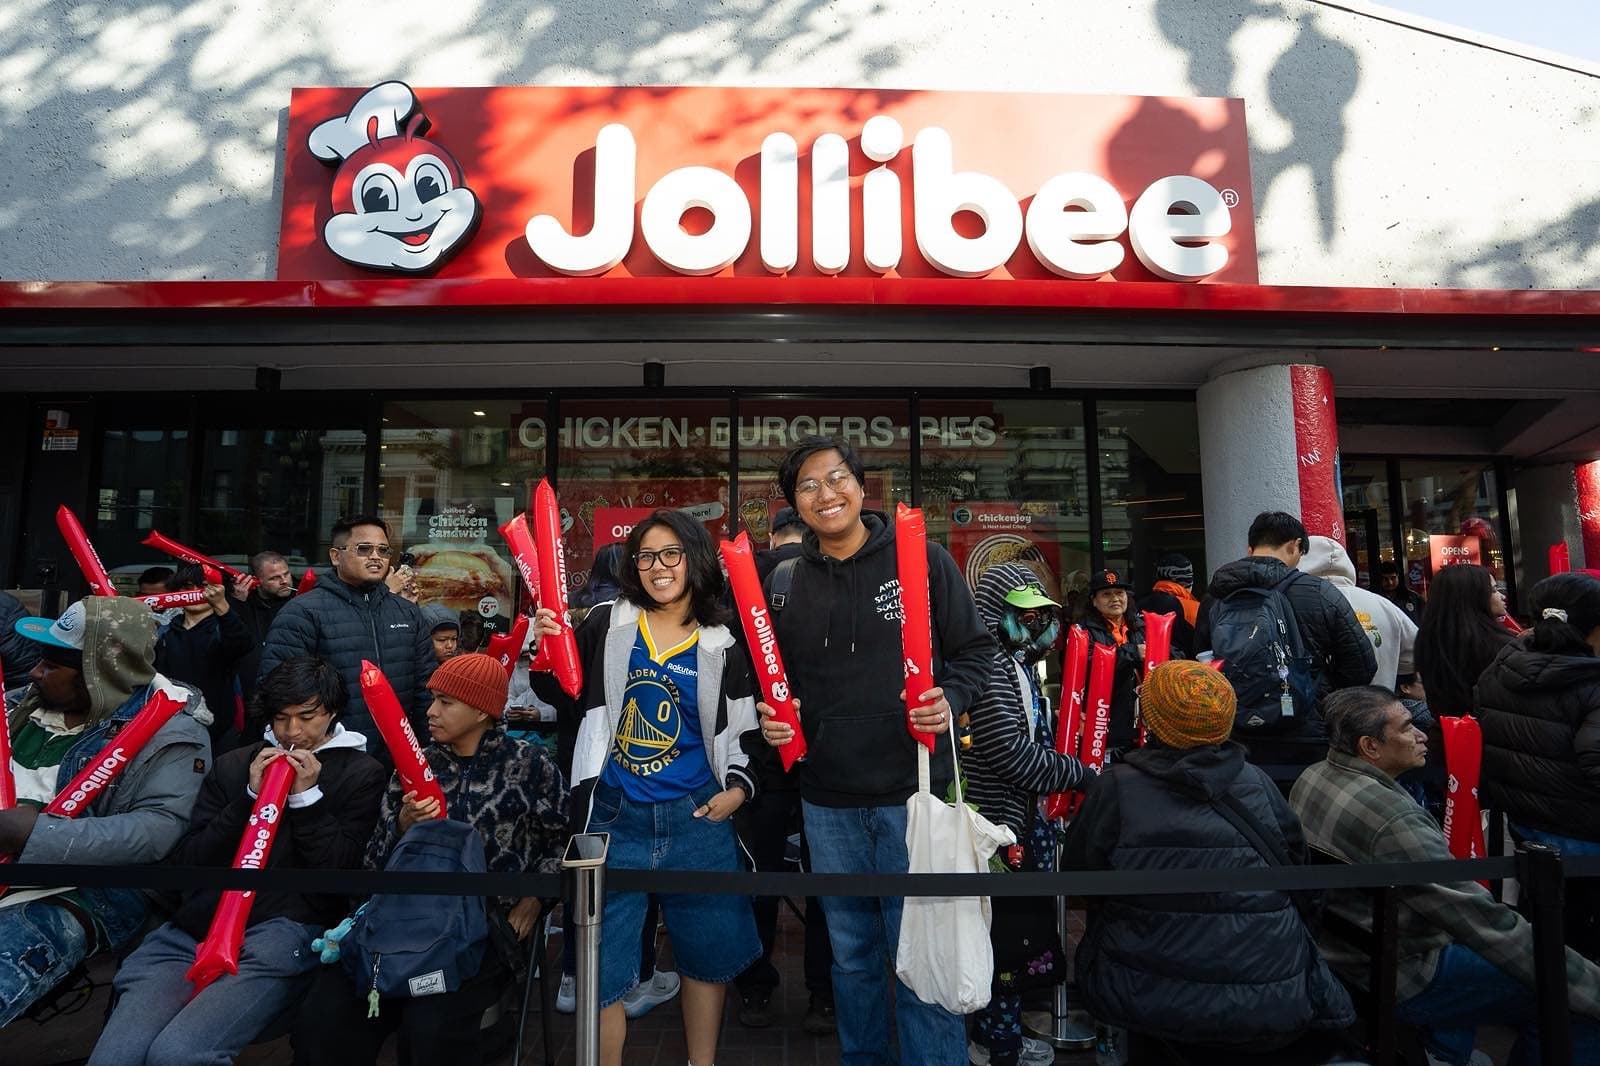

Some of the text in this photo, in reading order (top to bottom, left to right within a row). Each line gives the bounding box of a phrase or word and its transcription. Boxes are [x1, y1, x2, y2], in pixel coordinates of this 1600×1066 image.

[525, 115, 1232, 281] Jollibee
[518, 415, 996, 449] CHICKEN BURGERS PIES
[429, 514, 488, 527] Chicken
[691, 508, 712, 518] here!
[978, 513, 1032, 524] Chickenjoy
[428, 528, 488, 538] Sandwich
[1441, 546, 1470, 556] OPENS
[879, 579, 900, 594] ANTI
[884, 611, 903, 621] CLU
[751, 606, 779, 675] Jollibee
[666, 662, 698, 678] Rakuten
[628, 668, 680, 704] LDEN STATE
[657, 700, 671, 722] 0
[1091, 698, 1111, 758] Jollibee
[400, 717, 426, 766] Jollibee
[61, 747, 127, 812] Jollibee
